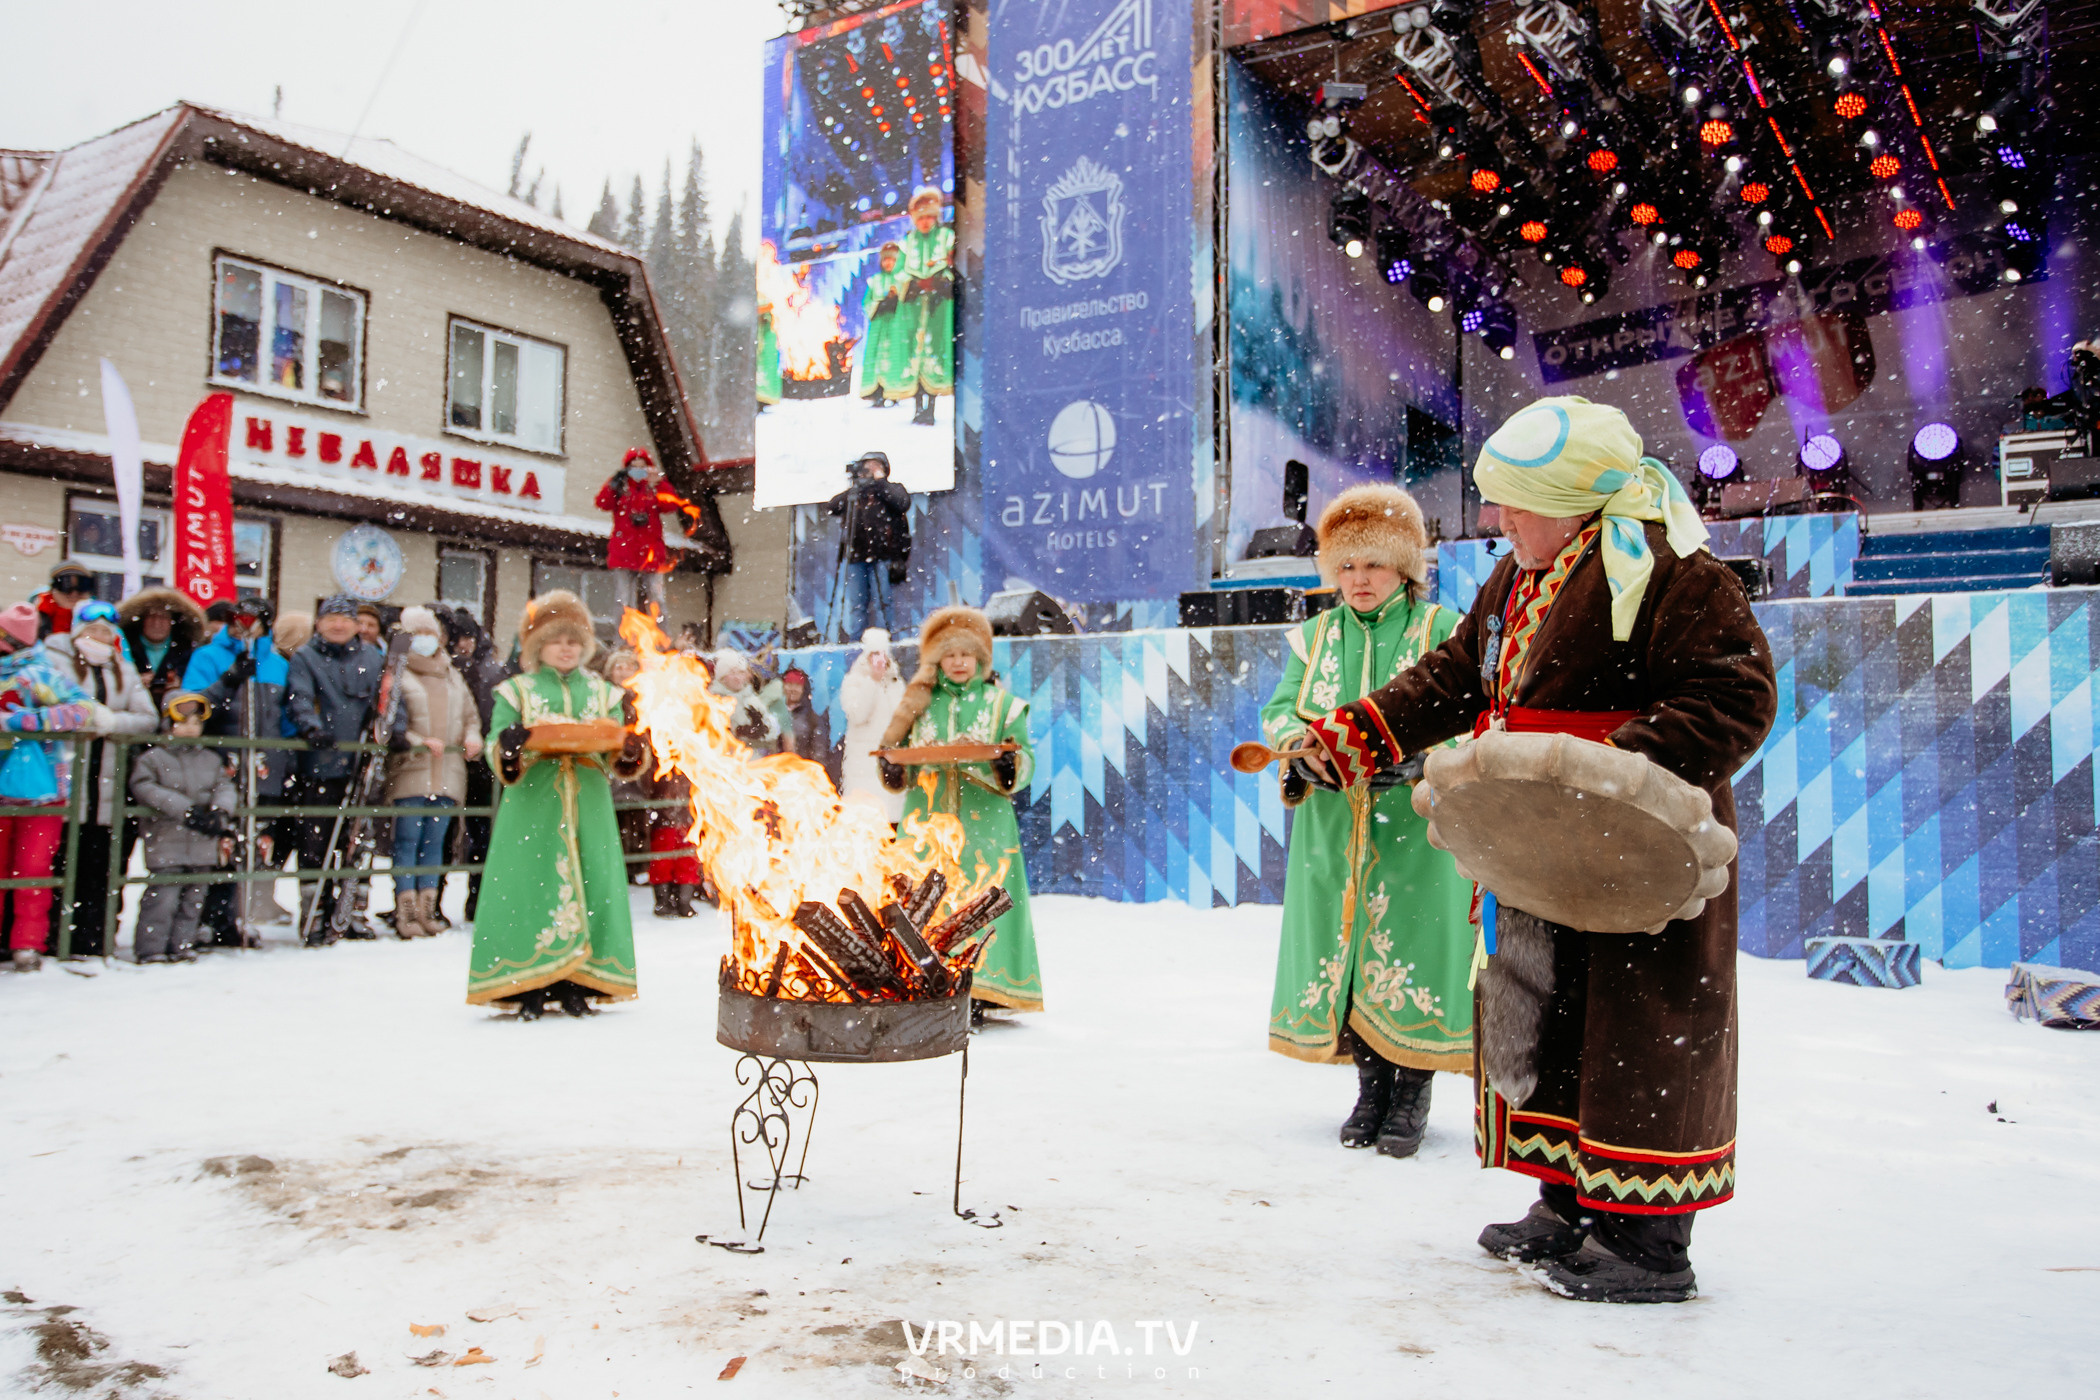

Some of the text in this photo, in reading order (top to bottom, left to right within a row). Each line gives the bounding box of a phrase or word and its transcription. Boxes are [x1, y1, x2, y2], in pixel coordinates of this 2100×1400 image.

[1014, 34, 1131, 83] 300 ЛЕТ
[1013, 51, 1159, 118] КУЗБАСС
[1020, 290, 1149, 331] Правительство
[1042, 327, 1122, 362] Кузбасса
[245, 416, 542, 500] НЕВАЛЯШКА
[1046, 529, 1117, 551] HOTELS
